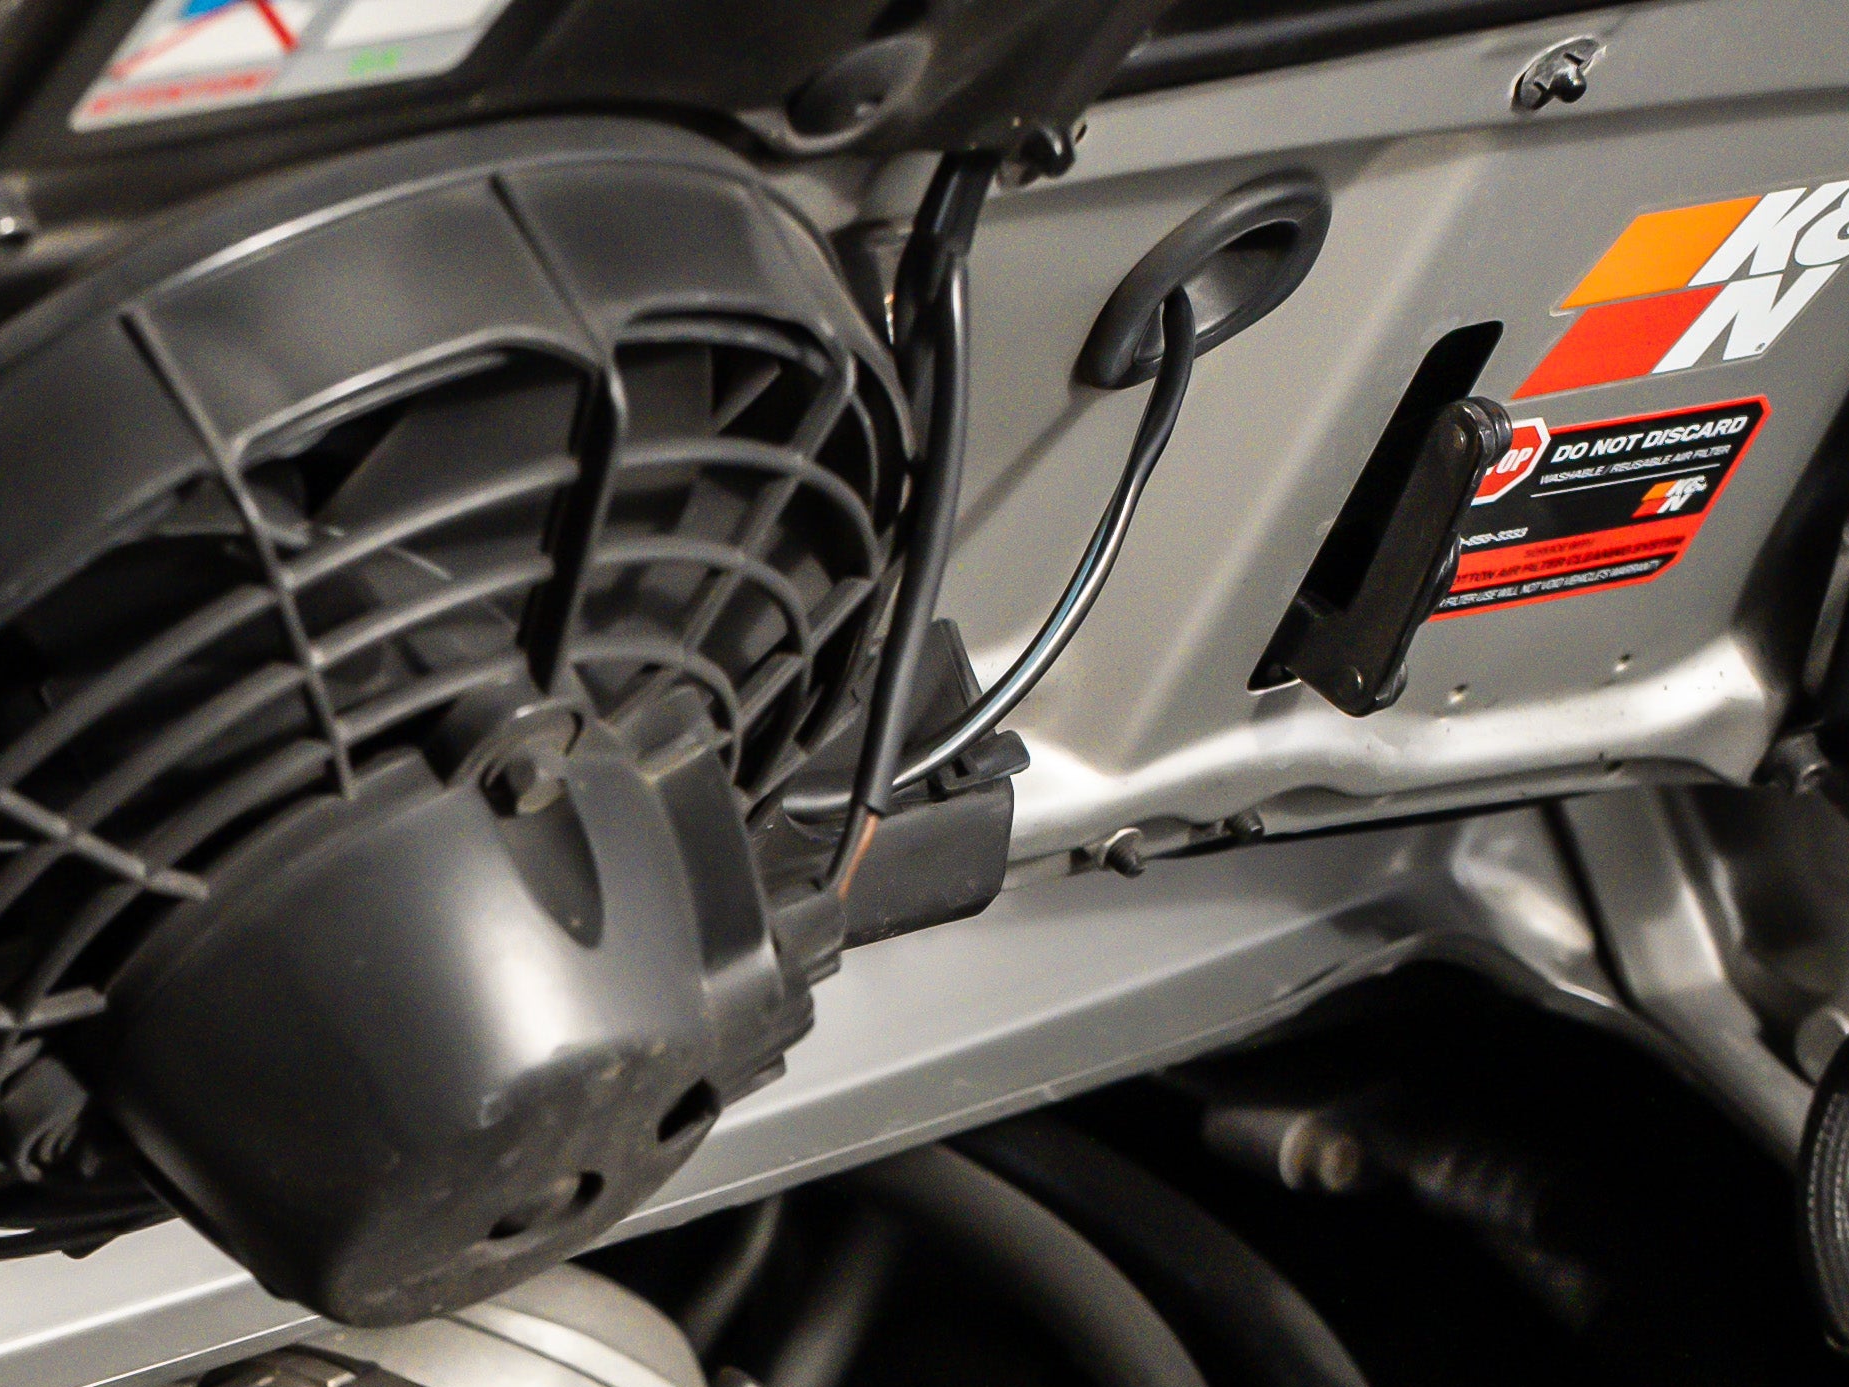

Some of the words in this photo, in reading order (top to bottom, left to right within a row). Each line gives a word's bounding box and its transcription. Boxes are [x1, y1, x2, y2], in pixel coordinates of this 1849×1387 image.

[1550, 441, 1589, 464] DO
[1588, 432, 1645, 458] NOT
[1640, 415, 1750, 450] DISCARD
[1485, 447, 1535, 477] OP
